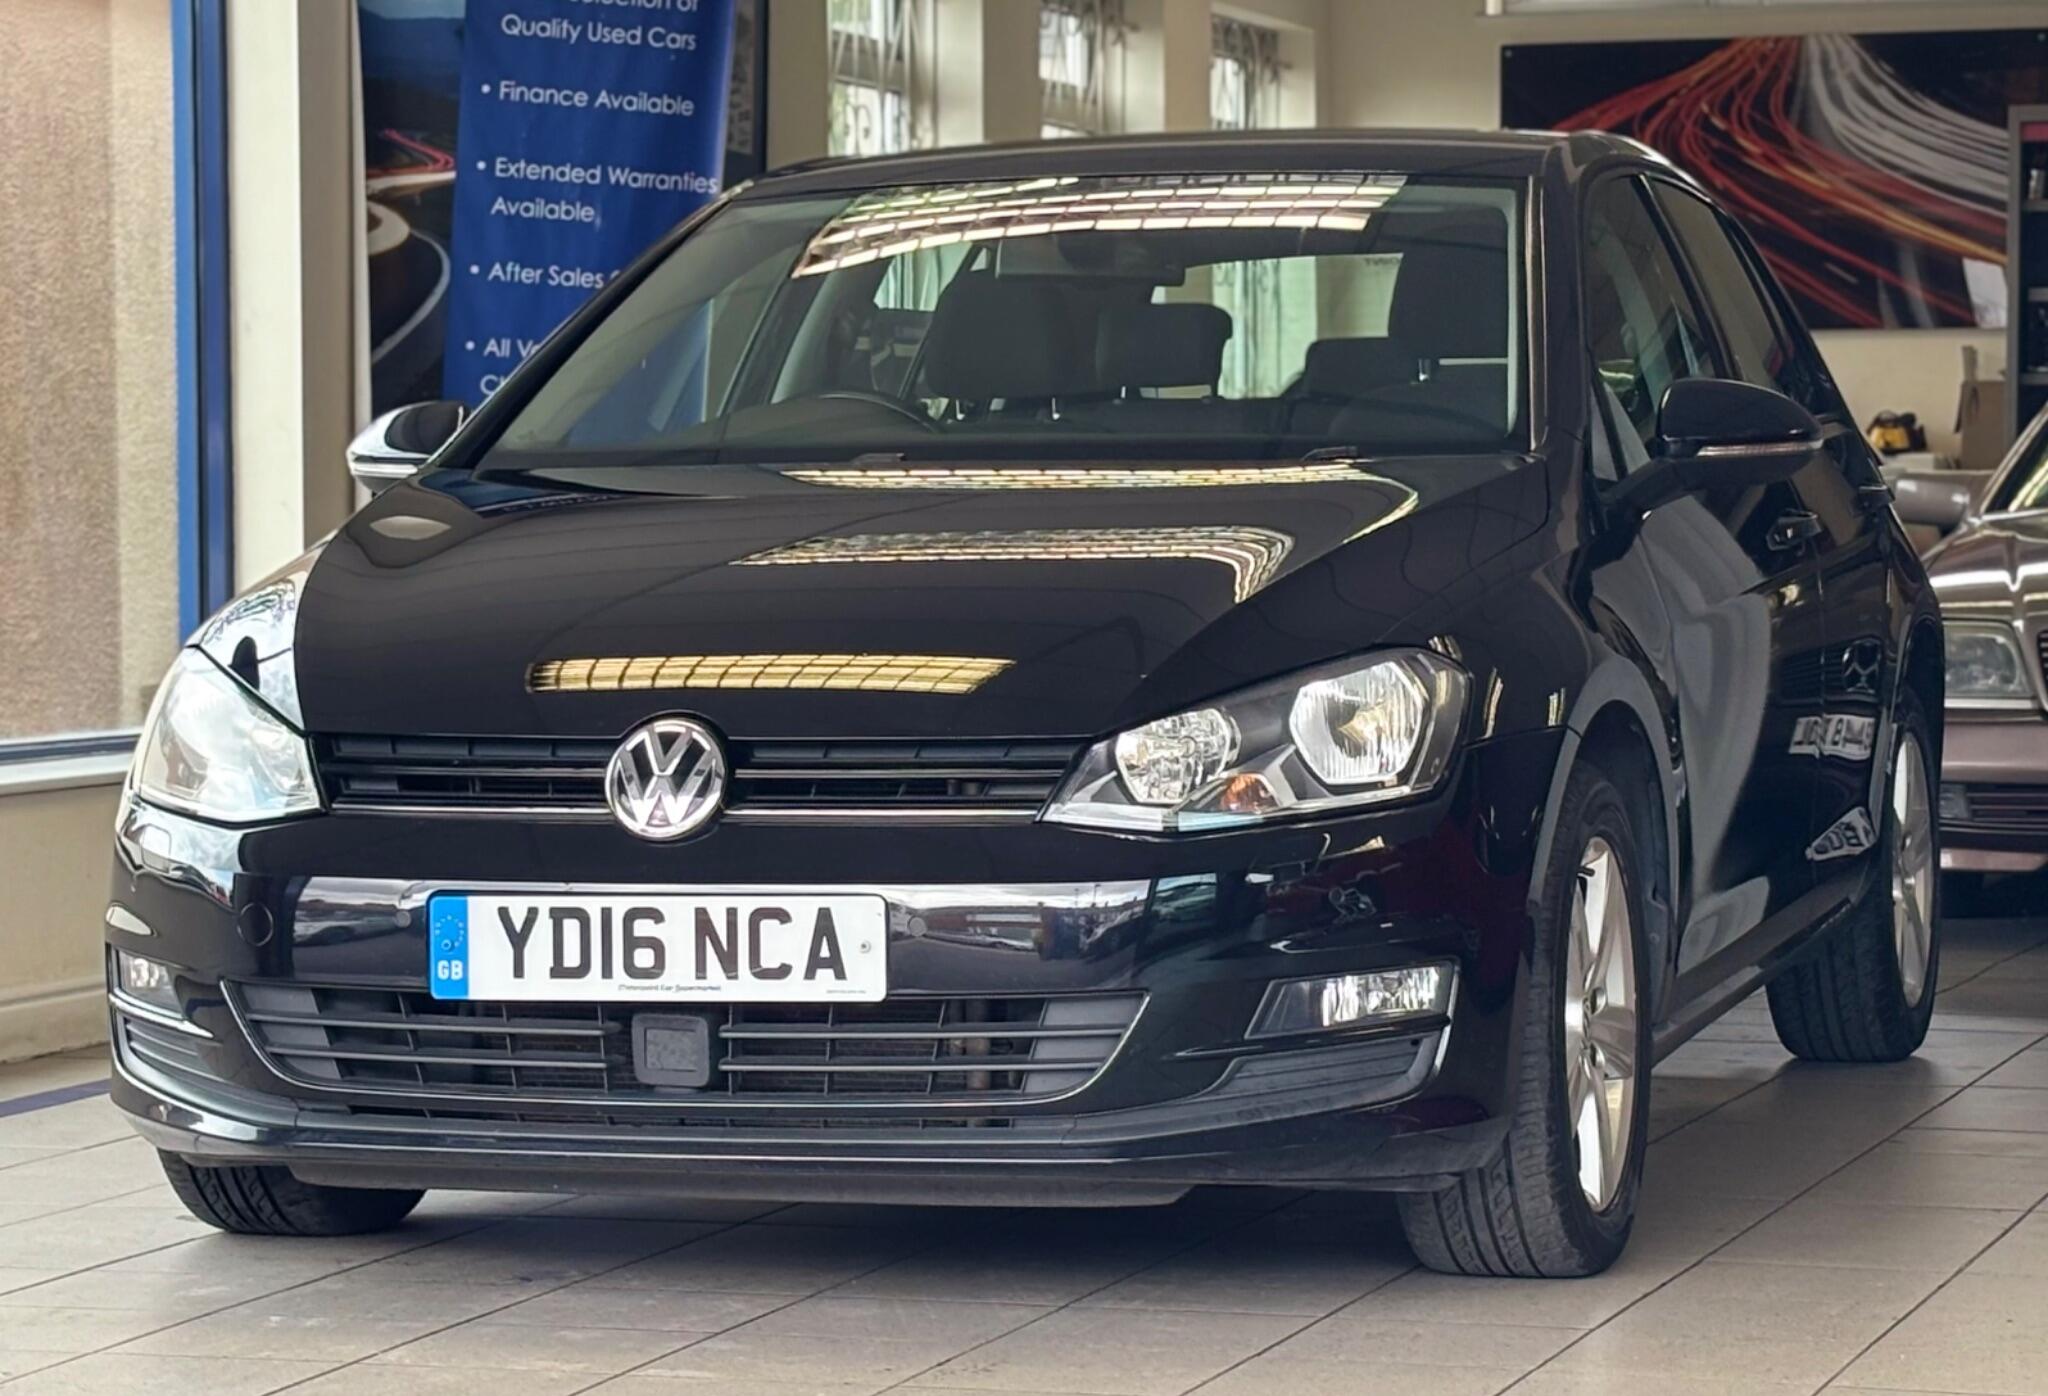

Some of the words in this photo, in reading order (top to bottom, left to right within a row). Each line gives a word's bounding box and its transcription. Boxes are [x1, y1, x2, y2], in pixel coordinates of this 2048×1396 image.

[501, 13, 582, 45] Quality
[587, 21, 642, 45] Used
[647, 26, 697, 50] Cars
[499, 80, 589, 107] Finance
[594, 89, 695, 116] Available
[494, 157, 601, 184] Extended
[607, 165, 719, 194] Warranties
[487, 261, 543, 284] After
[548, 265, 604, 289] Sales
[483, 338, 511, 358] All
[497, 906, 666, 980] YD16
[694, 907, 848, 981] NCA
[437, 960, 463, 980] GB
